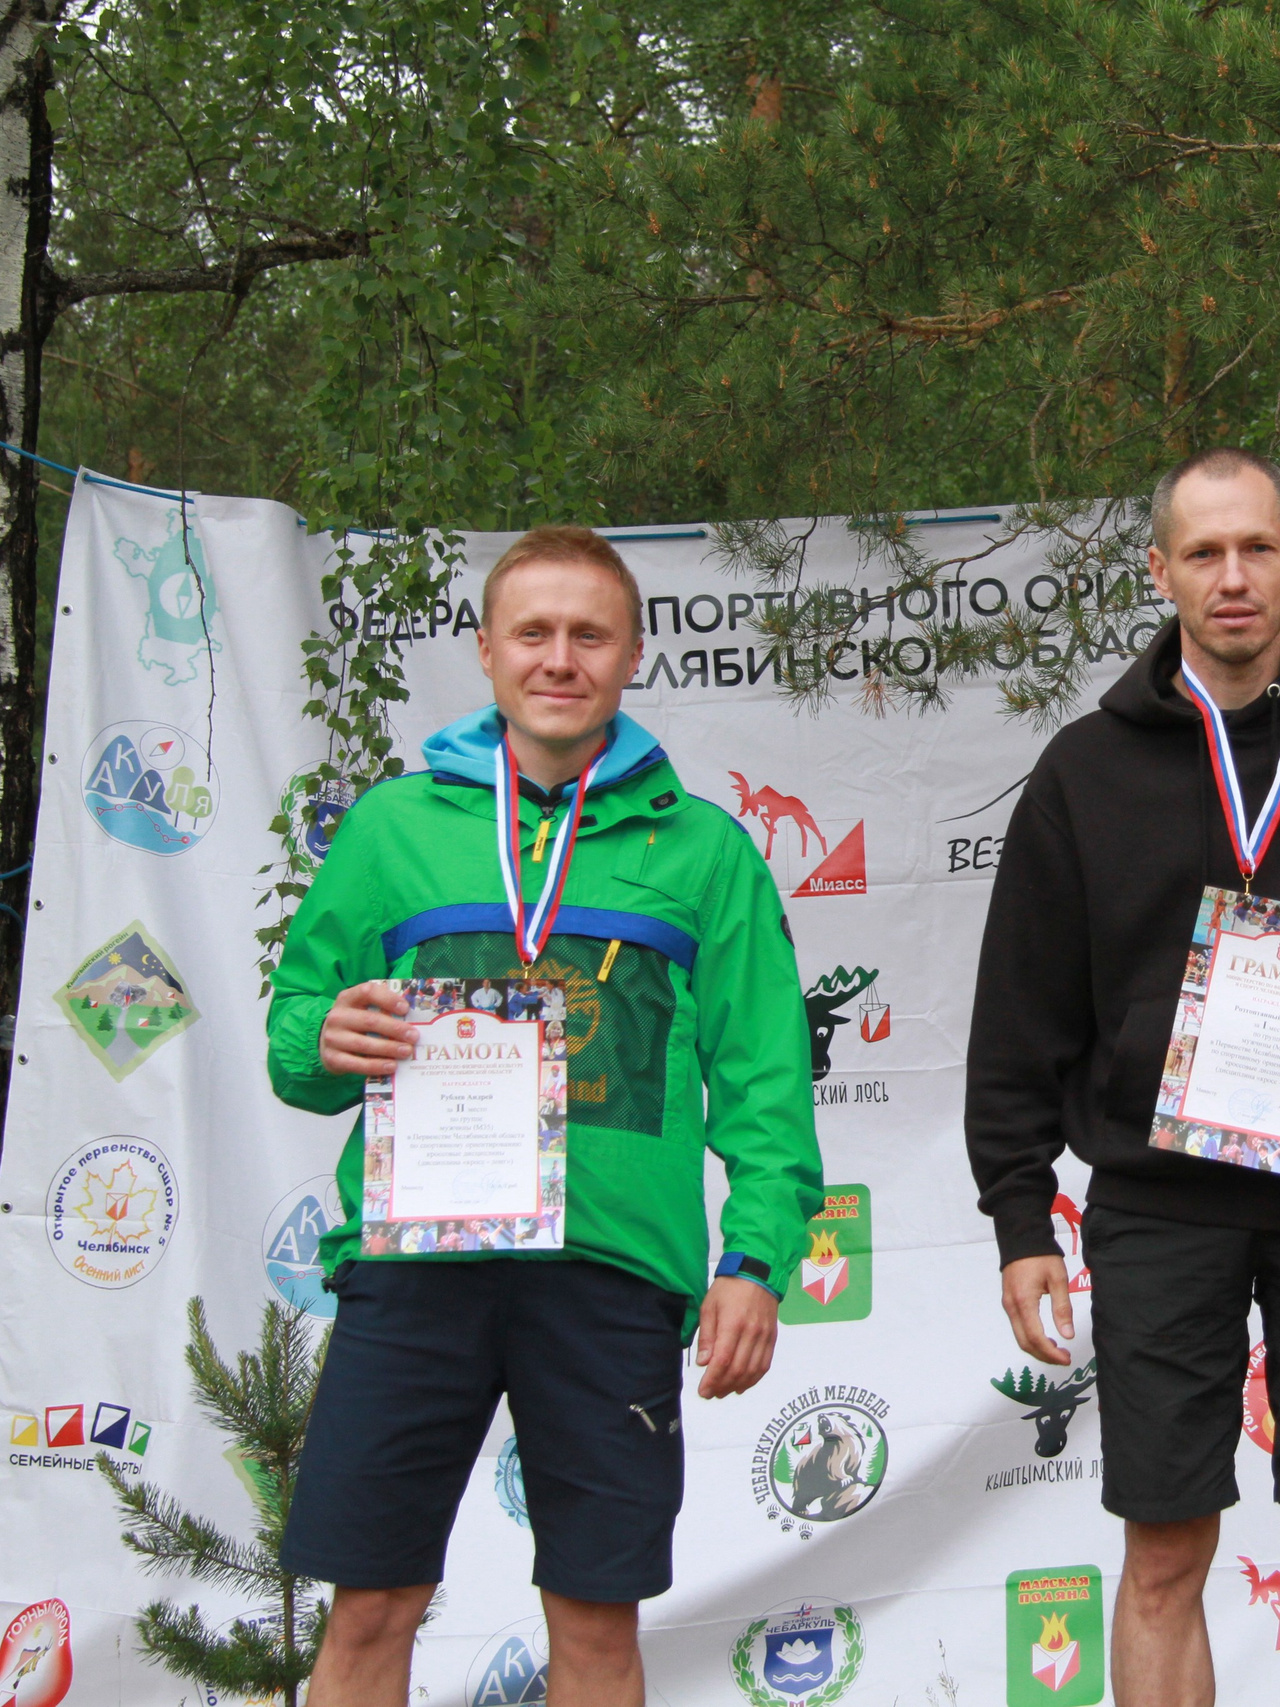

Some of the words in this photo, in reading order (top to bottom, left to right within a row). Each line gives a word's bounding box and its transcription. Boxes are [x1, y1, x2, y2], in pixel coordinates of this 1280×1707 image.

[328, 597, 481, 646] ФЕДЕРА
[639, 577, 1008, 637] ПОРТИВНОГО
[809, 878, 865, 893] Миасс
[409, 1042, 522, 1061] ГРАМОТА
[78, 1143, 157, 1167] первенство
[158, 1162, 174, 1207] СШОР
[53, 1167, 78, 1241] Открытое
[77, 1239, 150, 1254] Челябинск
[158, 1236, 166, 1246] 5
[74, 1255, 121, 1281] Осенний
[751, 1385, 821, 1505] ЧЕБАРКУЛЬСКИЙ
[824, 1385, 890, 1419] МЕДВЕДЬ
[9, 1453, 96, 1471] СЕМЕЙНЫЕ
[985, 1456, 1083, 1492] КЫШТЫМСКИЙ
[1019, 1575, 1090, 1591] МАЙСКАЯ
[1018, 1588, 1090, 1604] ПОЛЯНА
[52, 1601, 69, 1647] КОРОЛЬ
[766, 1619, 836, 1634] ЧЕБАРКУЛЬ
